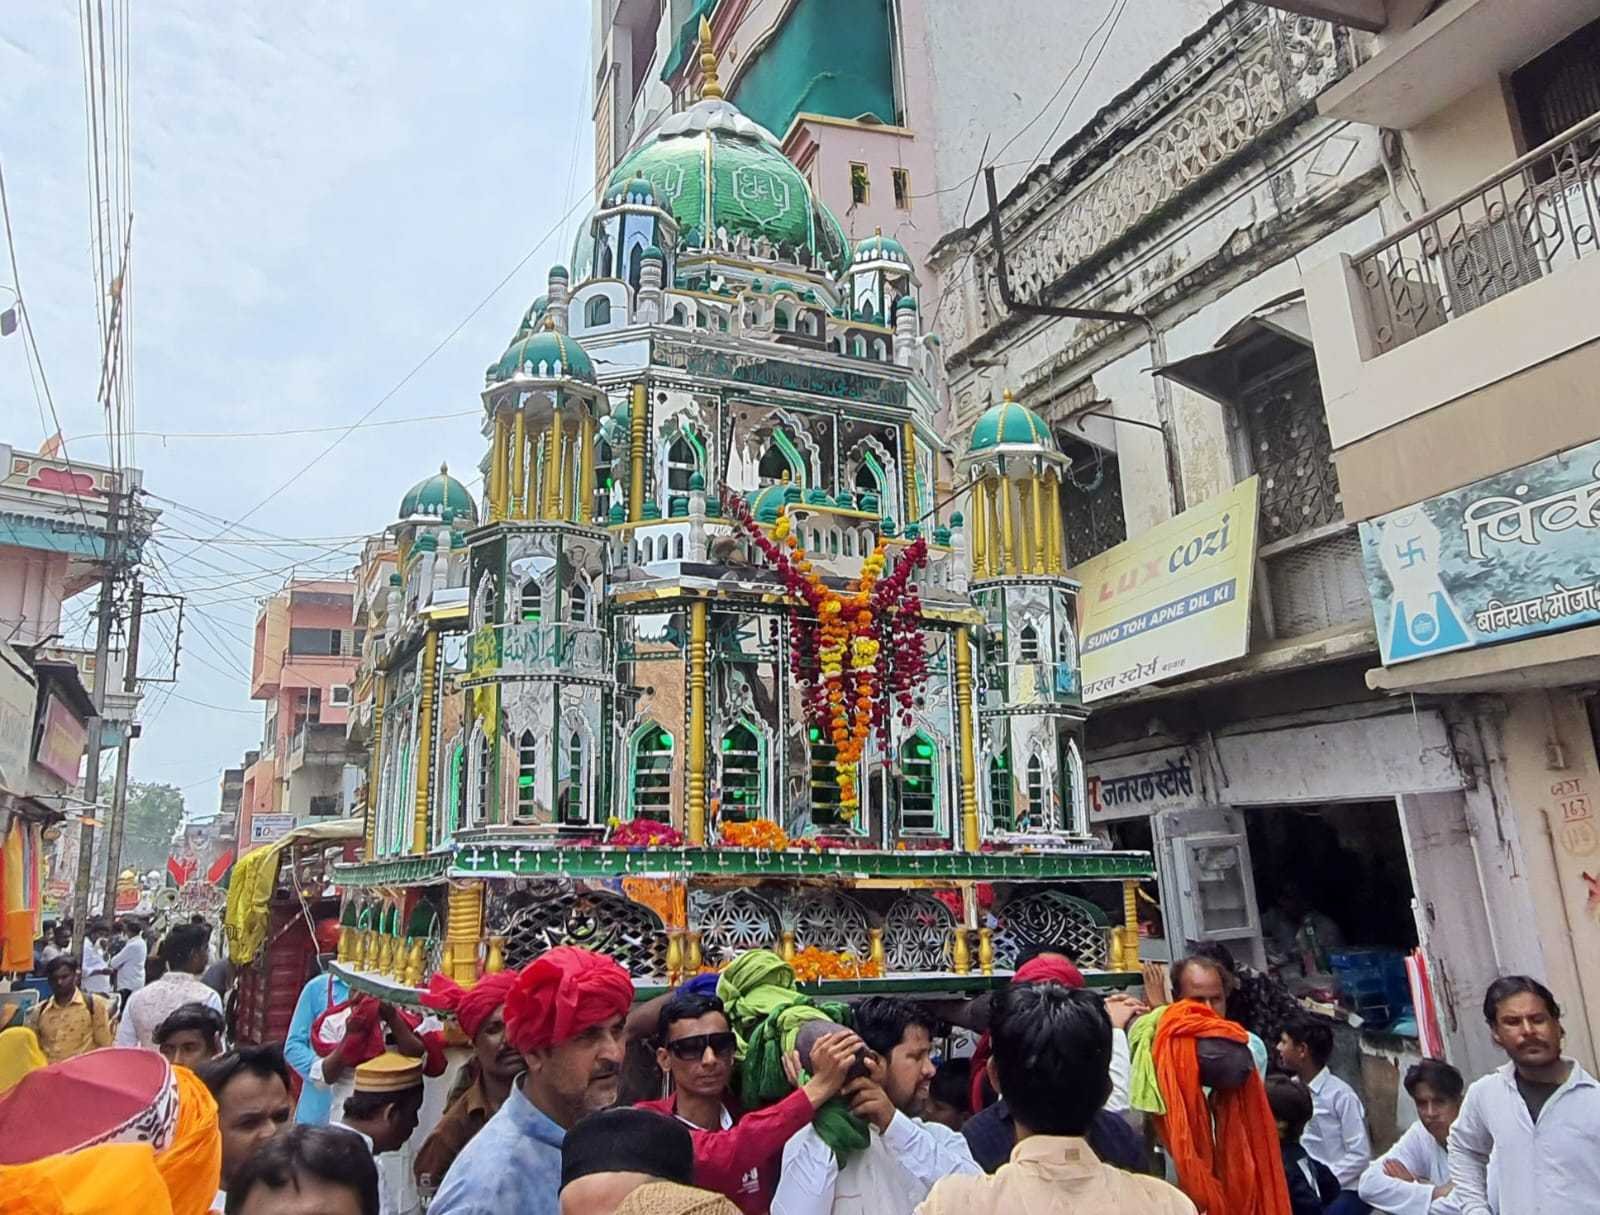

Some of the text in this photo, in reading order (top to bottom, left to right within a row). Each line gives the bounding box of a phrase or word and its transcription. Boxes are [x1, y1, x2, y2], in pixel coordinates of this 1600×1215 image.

[1462, 460, 1600, 560] पिंक
[1087, 584, 1229, 649] SUNO TOH APNE DIL KI
[1082, 674, 1116, 696] नरल
[1118, 655, 1160, 685] स्टोर्स
[1101, 769, 1156, 807] जनरल
[1561, 799, 1587, 819] 163
